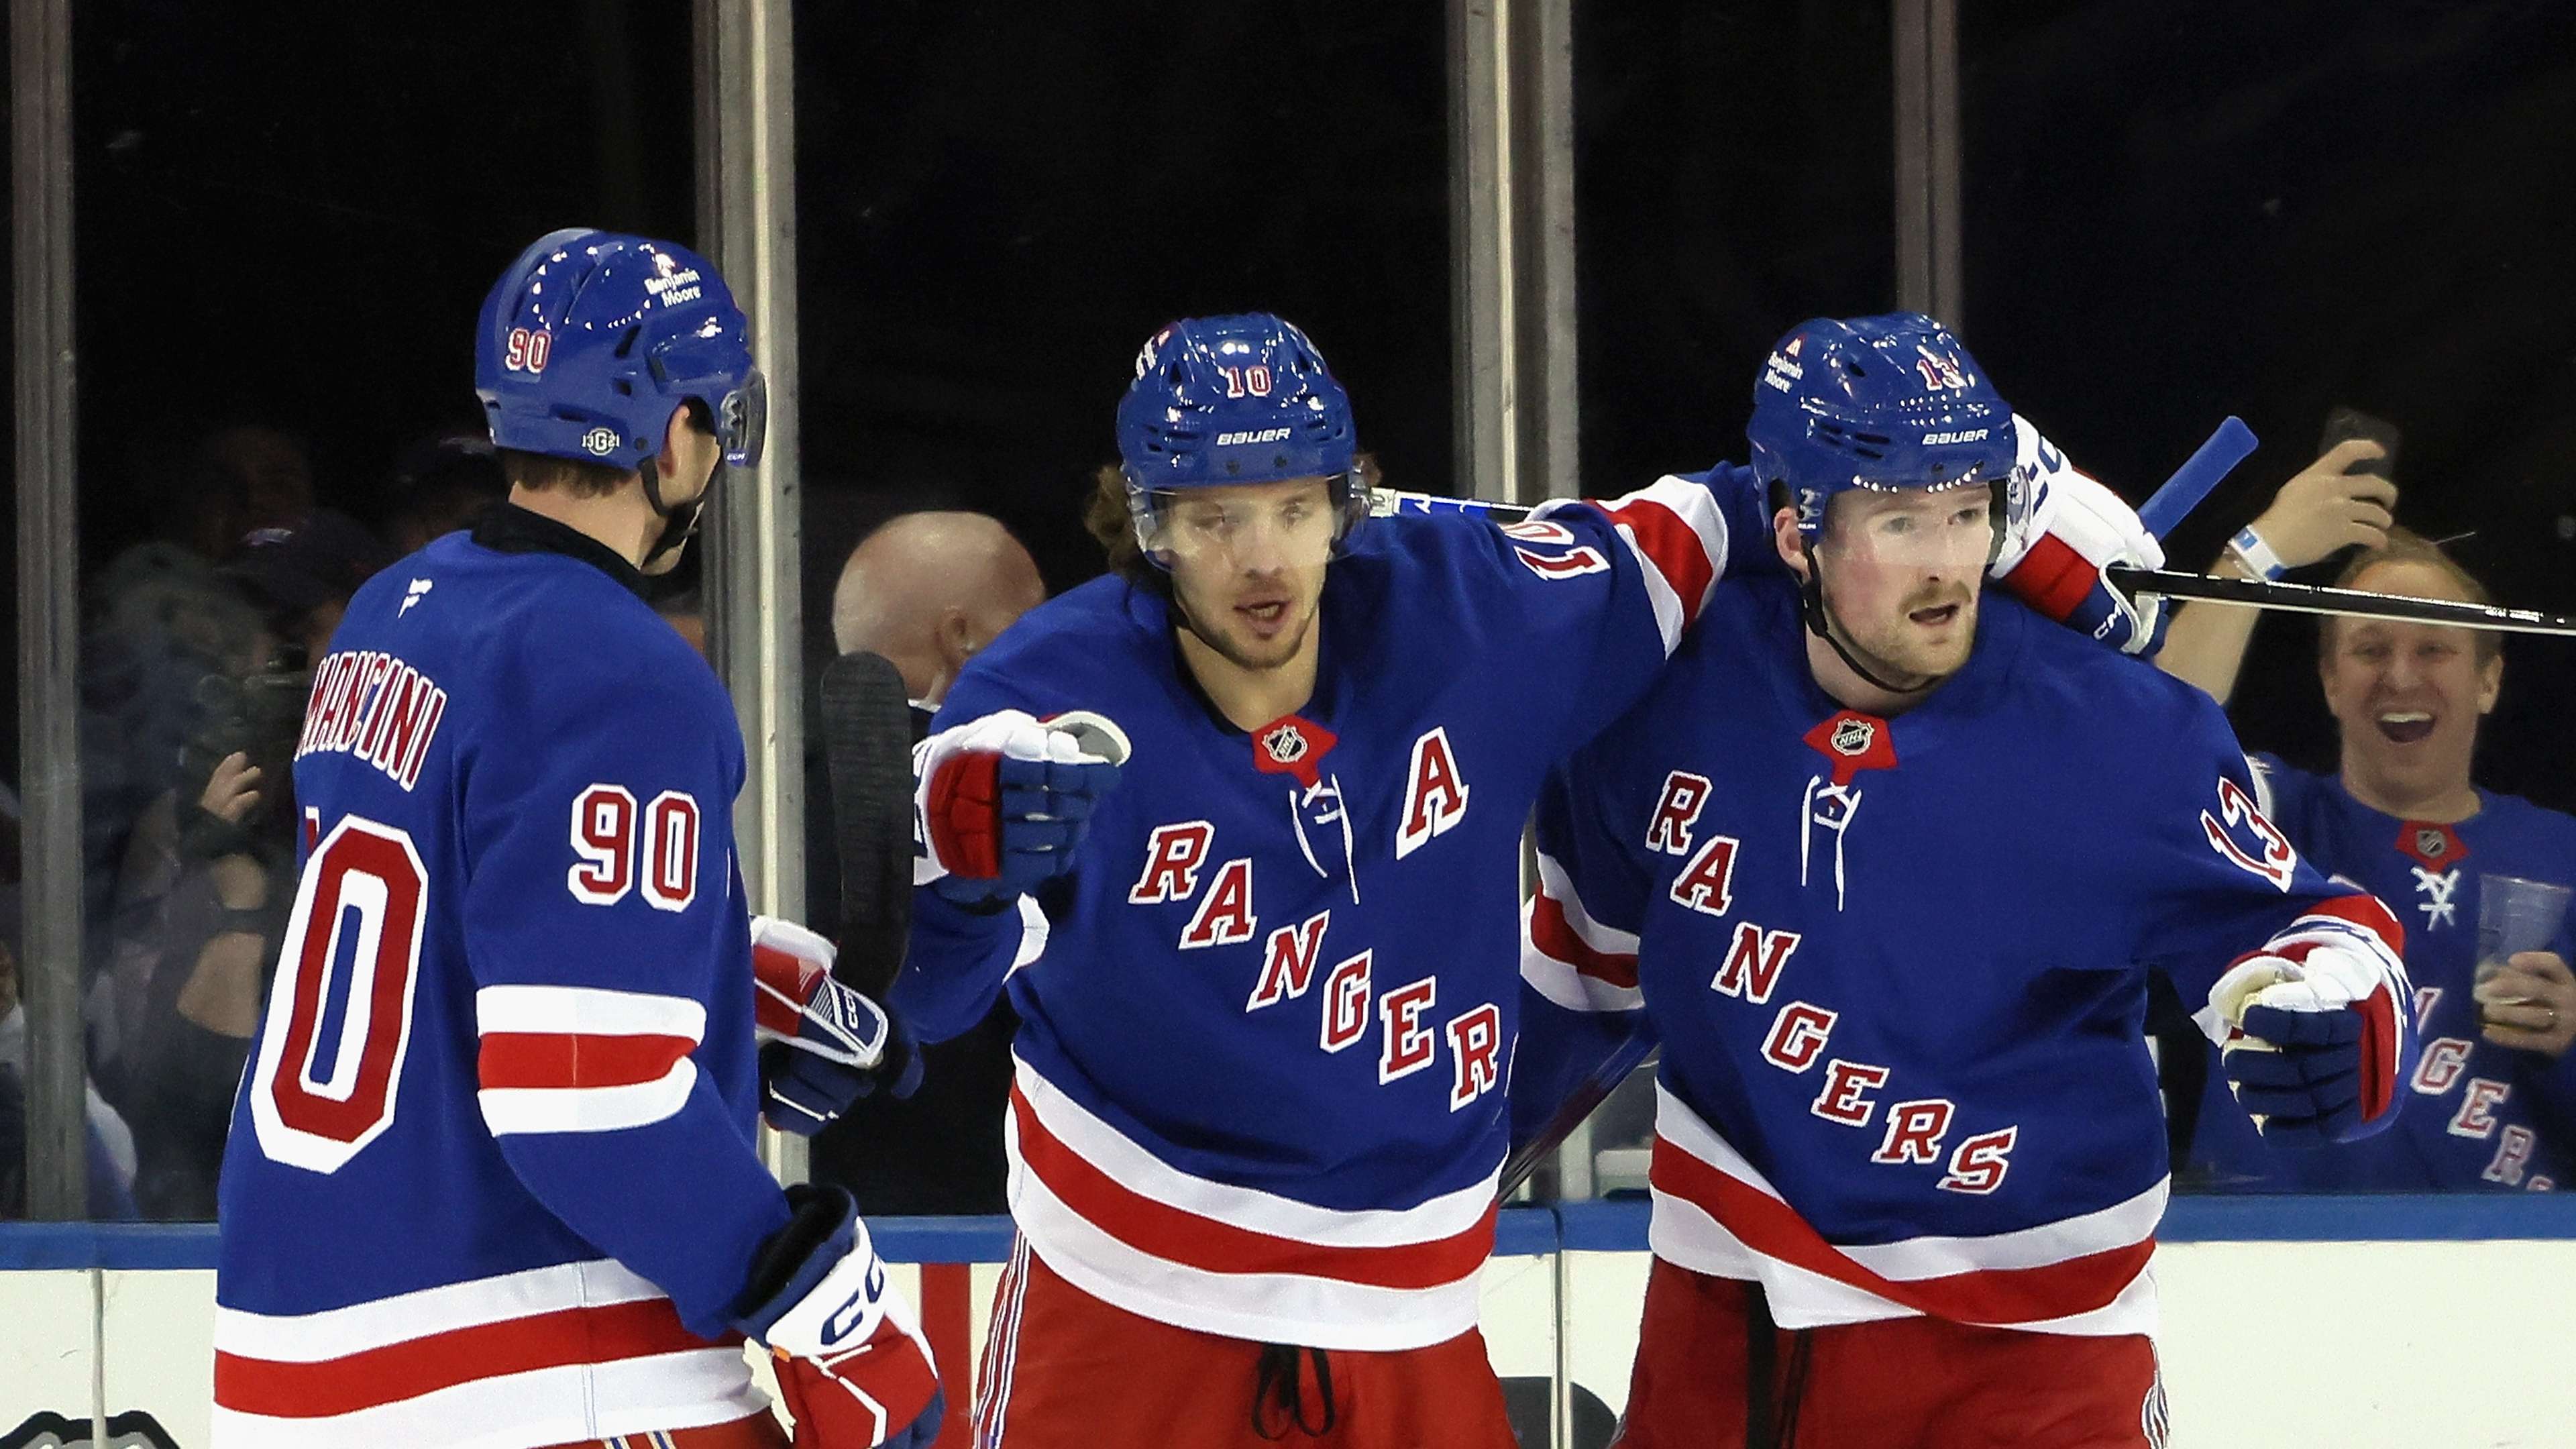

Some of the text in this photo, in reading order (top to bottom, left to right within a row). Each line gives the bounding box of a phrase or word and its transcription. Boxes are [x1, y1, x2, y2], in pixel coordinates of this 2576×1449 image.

[505, 327, 551, 374] 90
[661, 286, 702, 307] Moore
[1226, 366, 1272, 398] 10
[1497, 520, 1611, 581] 10
[293, 651, 448, 793] MANCINI
[568, 783, 700, 912] 90
[1396, 726, 1469, 861] A
[2200, 775, 2297, 894] 13
[250, 806, 429, 1175] 0
[1128, 820, 1501, 1114] RANGER
[1646, 770, 2018, 1194] RANGERS
